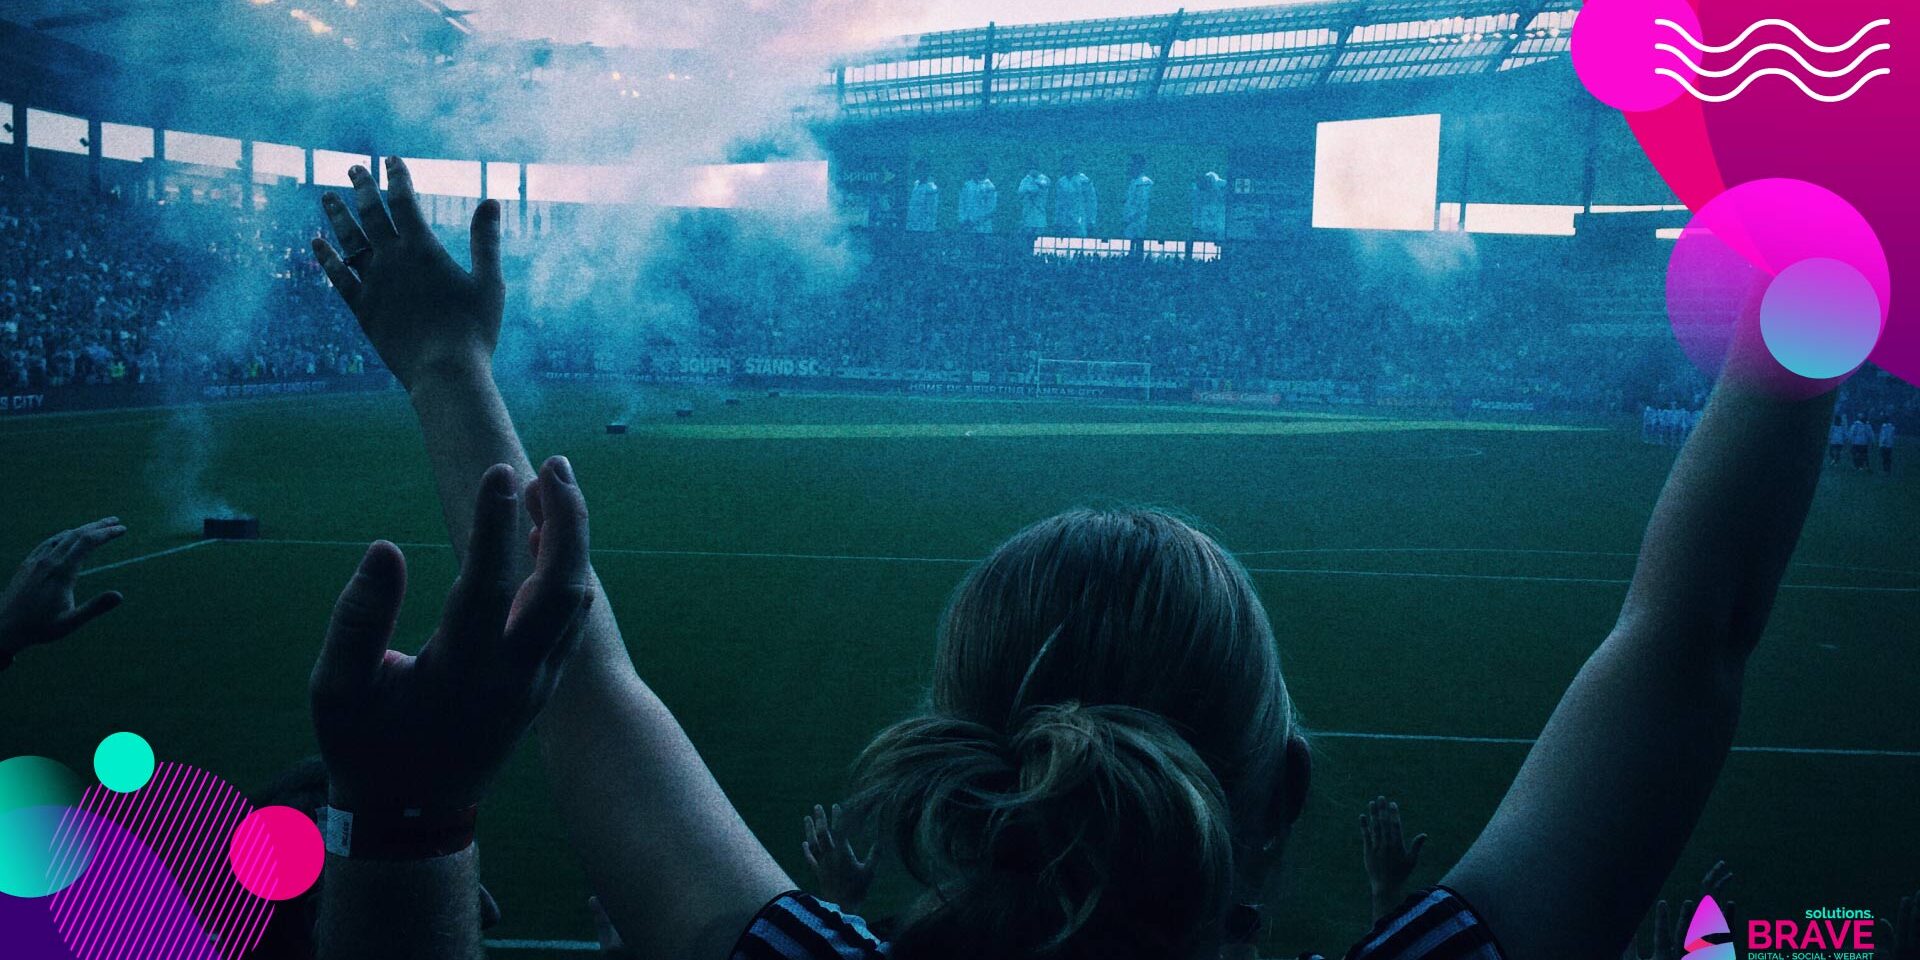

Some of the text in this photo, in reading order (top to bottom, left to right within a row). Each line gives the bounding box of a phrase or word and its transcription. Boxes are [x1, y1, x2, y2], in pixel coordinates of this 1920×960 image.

[679, 357, 731, 374] SOUTH
[745, 357, 795, 376] STAND
[13, 394, 44, 410] CITY
